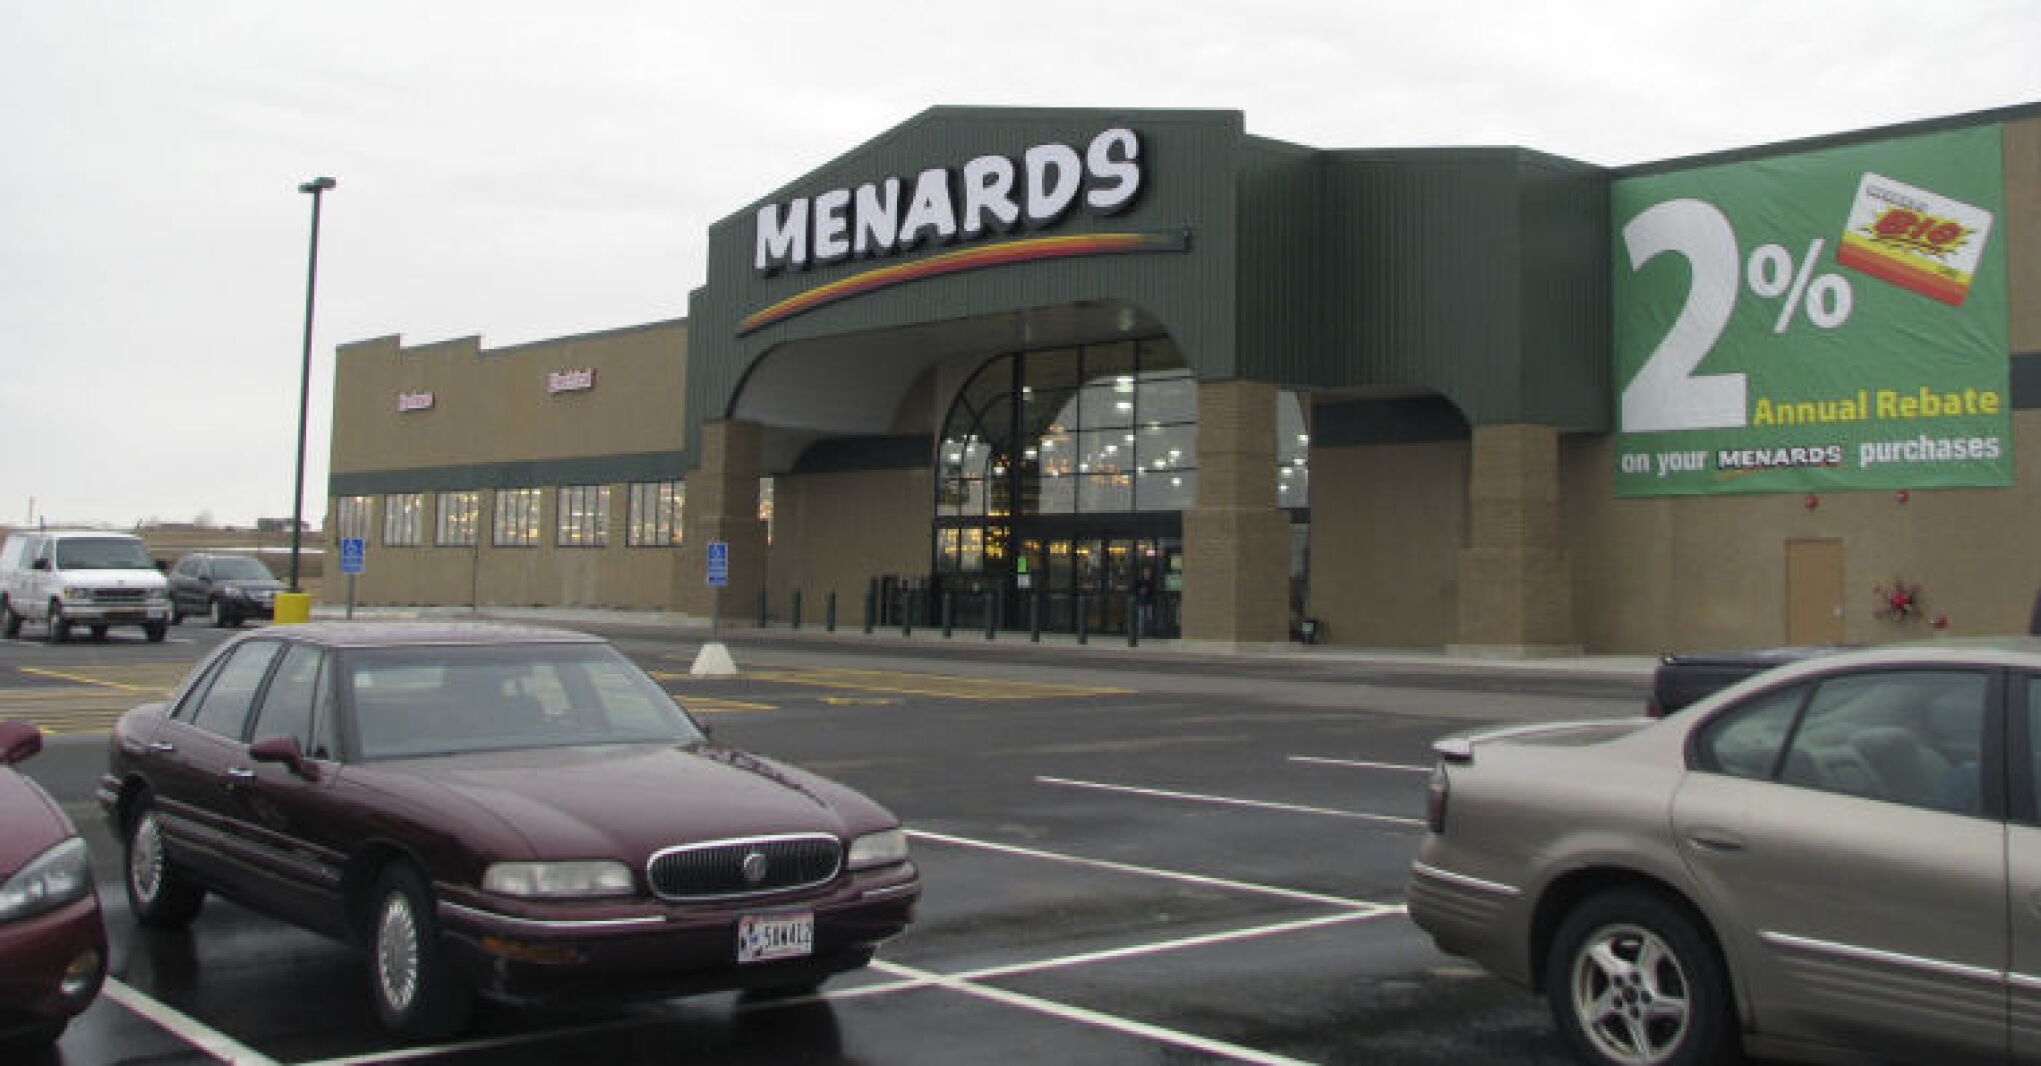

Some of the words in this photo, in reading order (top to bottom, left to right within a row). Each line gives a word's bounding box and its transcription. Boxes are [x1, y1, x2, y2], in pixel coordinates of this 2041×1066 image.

[754, 128, 1140, 270] MENARDS
[1621, 198, 1854, 433] 2%
[1753, 391, 1868, 425] Annual
[1877, 386, 2001, 418] Rebate
[1621, 452, 1650, 473] on
[1656, 451, 1709, 479] your
[1718, 446, 1843, 471] MENARDS
[1860, 435, 2002, 469] purchases
